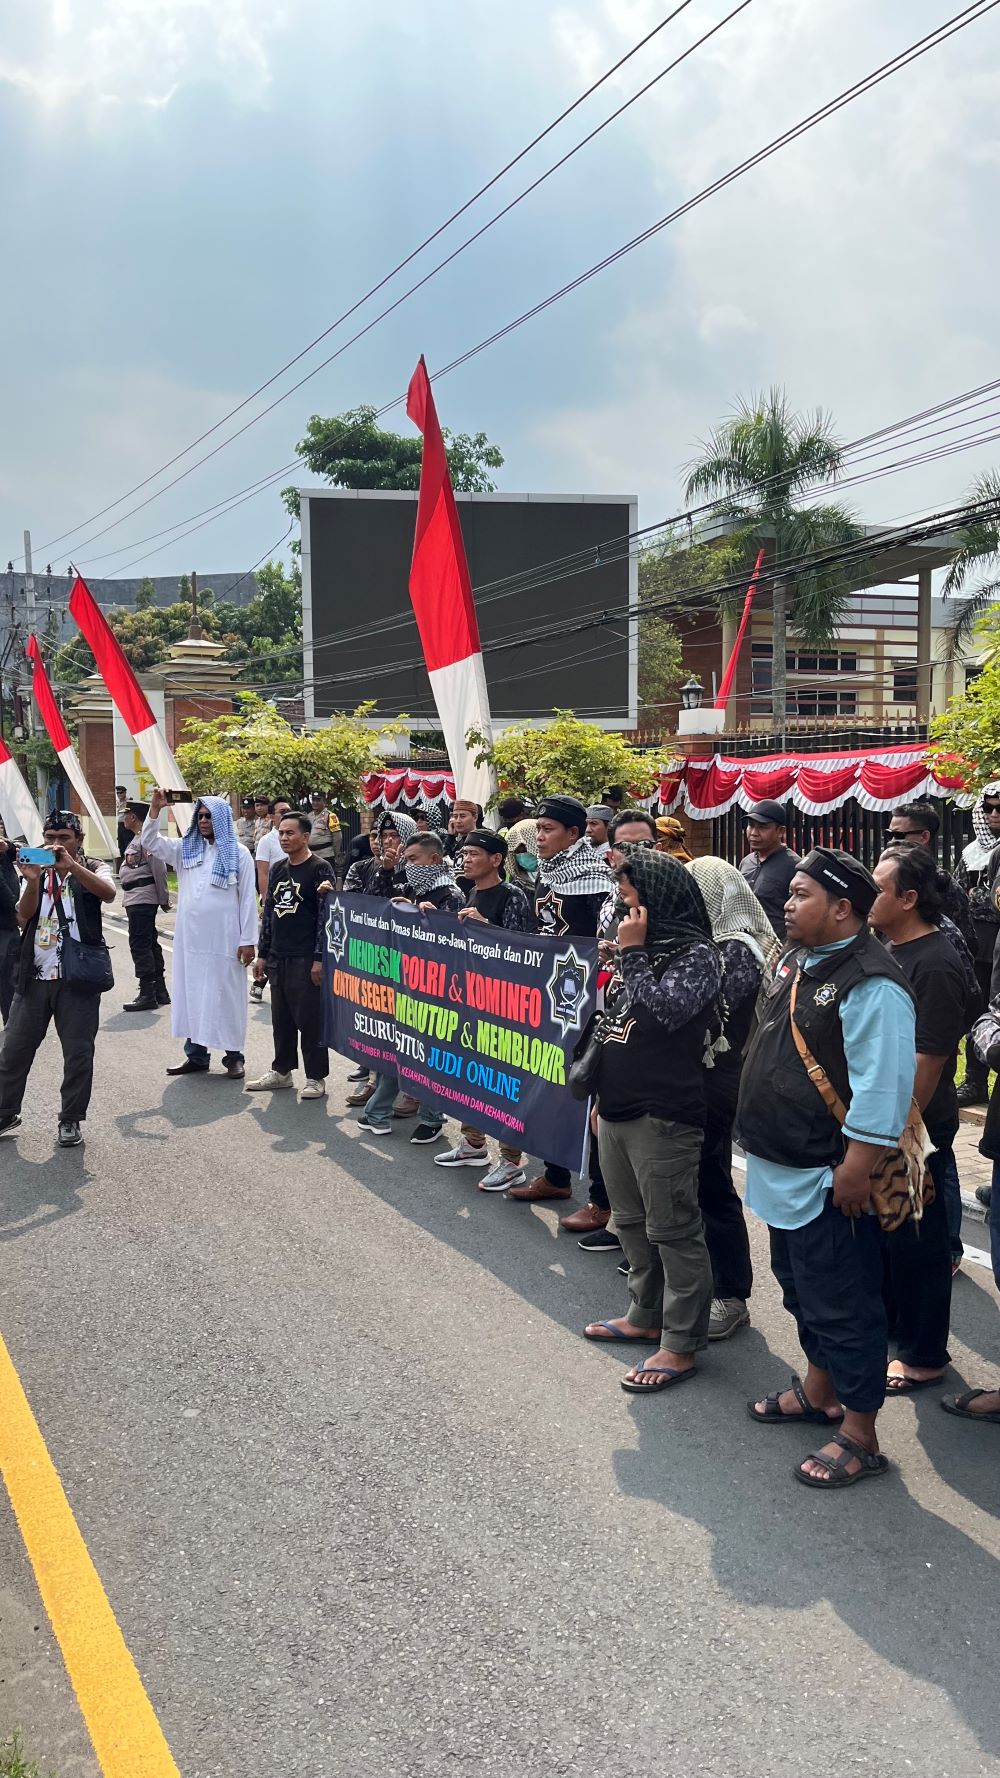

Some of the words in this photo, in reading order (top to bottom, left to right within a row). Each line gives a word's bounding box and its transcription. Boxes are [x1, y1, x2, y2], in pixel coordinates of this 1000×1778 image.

[350, 910, 363, 924] Kami
[364, 913, 378, 928] Umat
[378, 917, 390, 930] dan
[412, 925, 436, 942] Islam
[467, 938, 500, 960] Tengah
[504, 946, 521, 964] dan
[524, 950, 544, 968] DIY
[333, 969, 360, 1004] UNTUK
[396, 992, 458, 1042] MENUTUP
[461, 1022, 474, 1050] &
[477, 1020, 566, 1086] MEMBLOKIR
[402, 953, 446, 998] POLRI
[448, 973, 463, 1004] &
[466, 970, 542, 1028] KOMINFO
[362, 1044, 380, 1058] SUMBER
[470, 1098, 484, 1114] DAN
[484, 1104, 525, 1134] KEHANCURAN
[395, 1030, 425, 1062] SITUS
[428, 1046, 463, 1078] JUDI
[466, 1060, 520, 1103] ONLINE
